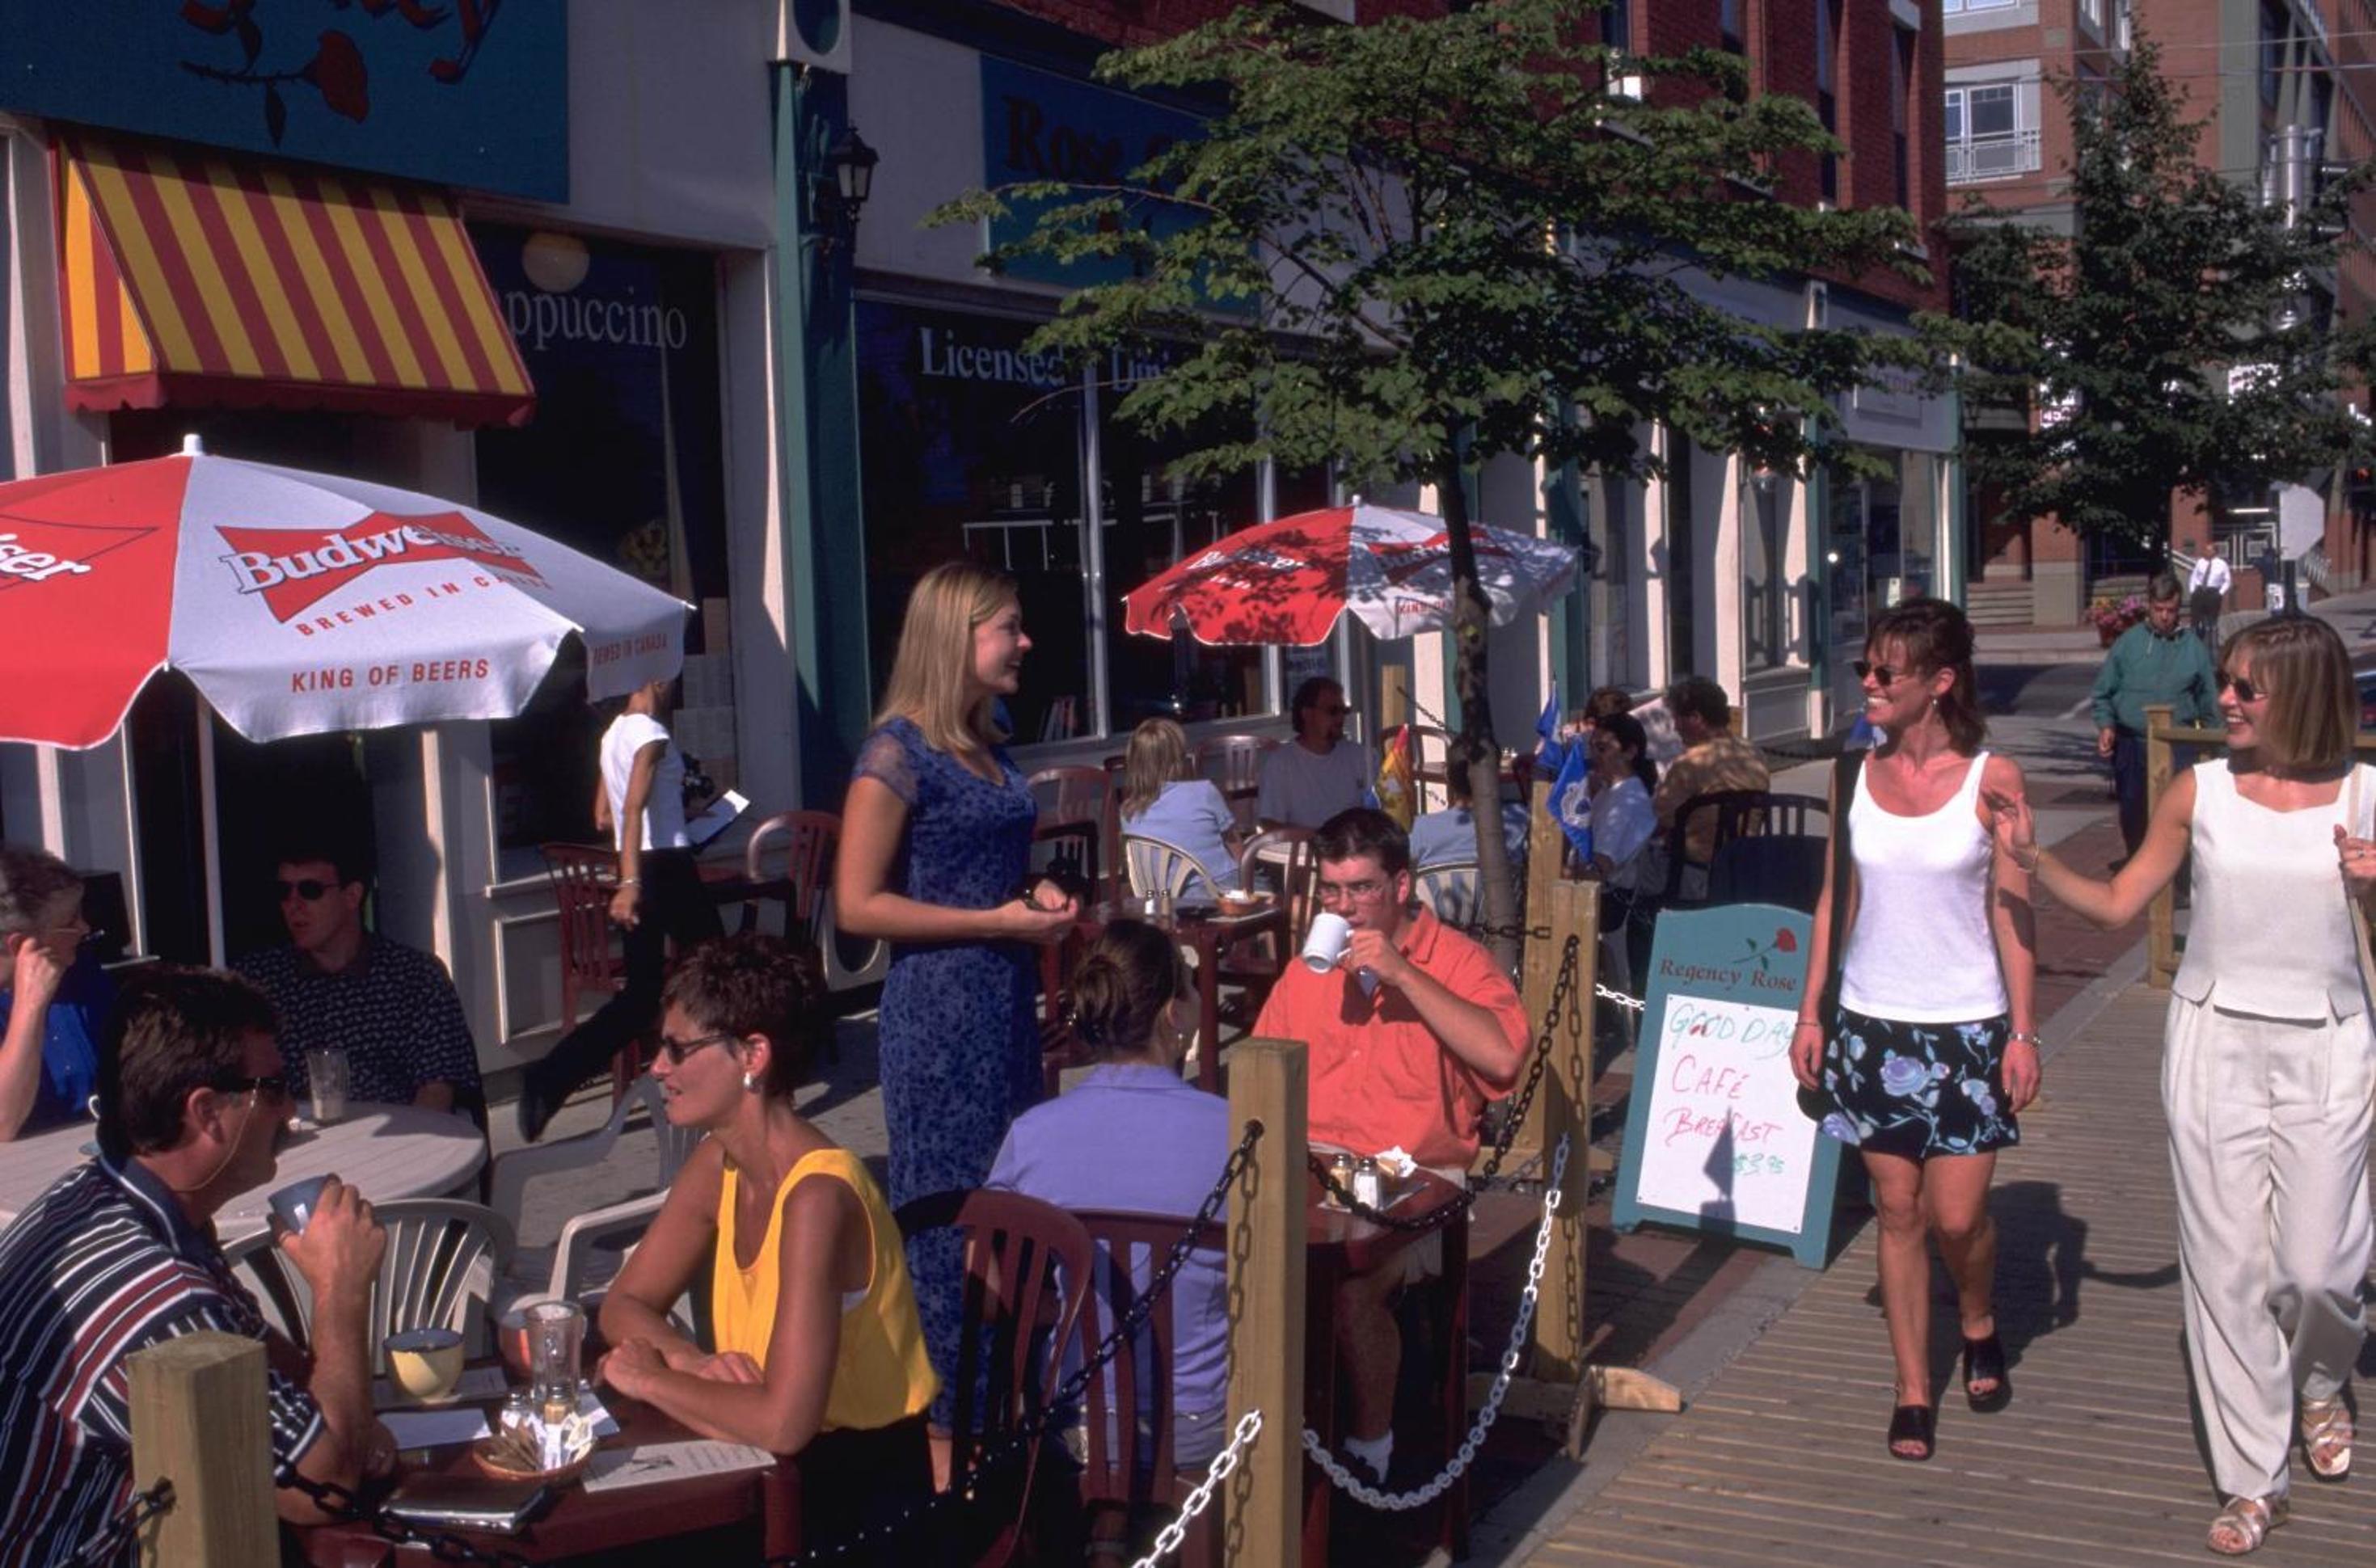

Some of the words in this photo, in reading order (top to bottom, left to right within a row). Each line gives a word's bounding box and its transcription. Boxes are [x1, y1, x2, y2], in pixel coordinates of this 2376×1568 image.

[501, 286, 687, 351] ppuccino
[918, 326, 1066, 388] Licensed
[219, 524, 523, 595] Budweiser
[294, 592, 416, 637] BREWED
[424, 581, 461, 599] IN
[292, 668, 354, 693] KING
[369, 664, 399, 687] OF
[411, 658, 490, 684] BEERS
[1660, 958, 1742, 992] Regency
[1750, 969, 1797, 992] Rose
